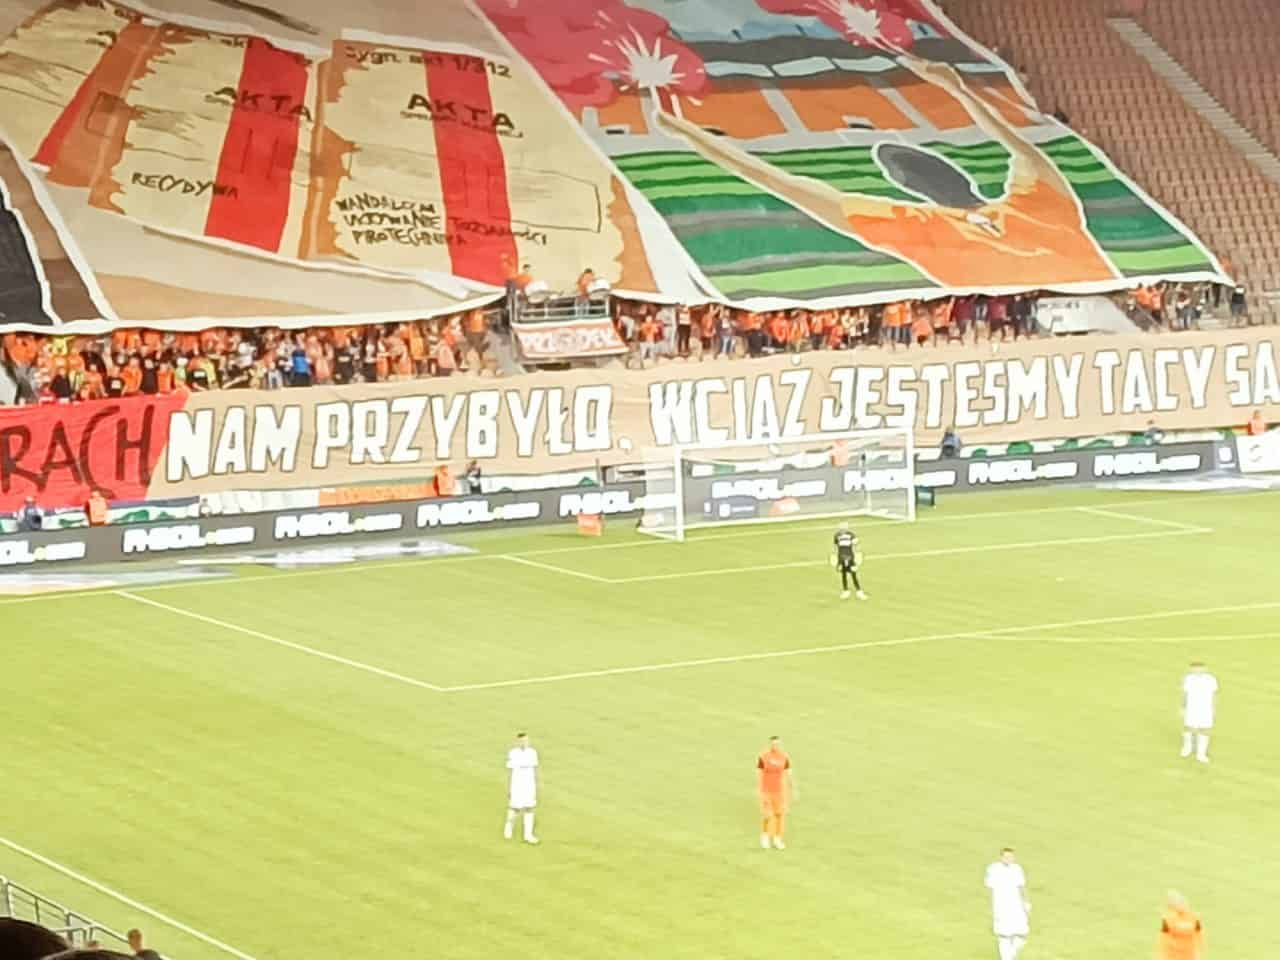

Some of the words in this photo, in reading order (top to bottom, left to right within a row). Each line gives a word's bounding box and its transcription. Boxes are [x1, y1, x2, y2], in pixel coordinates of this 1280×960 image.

[407, 93, 516, 131] AKTA
[165, 404, 302, 482] NAM
[1094, 346, 1216, 416] TACY
